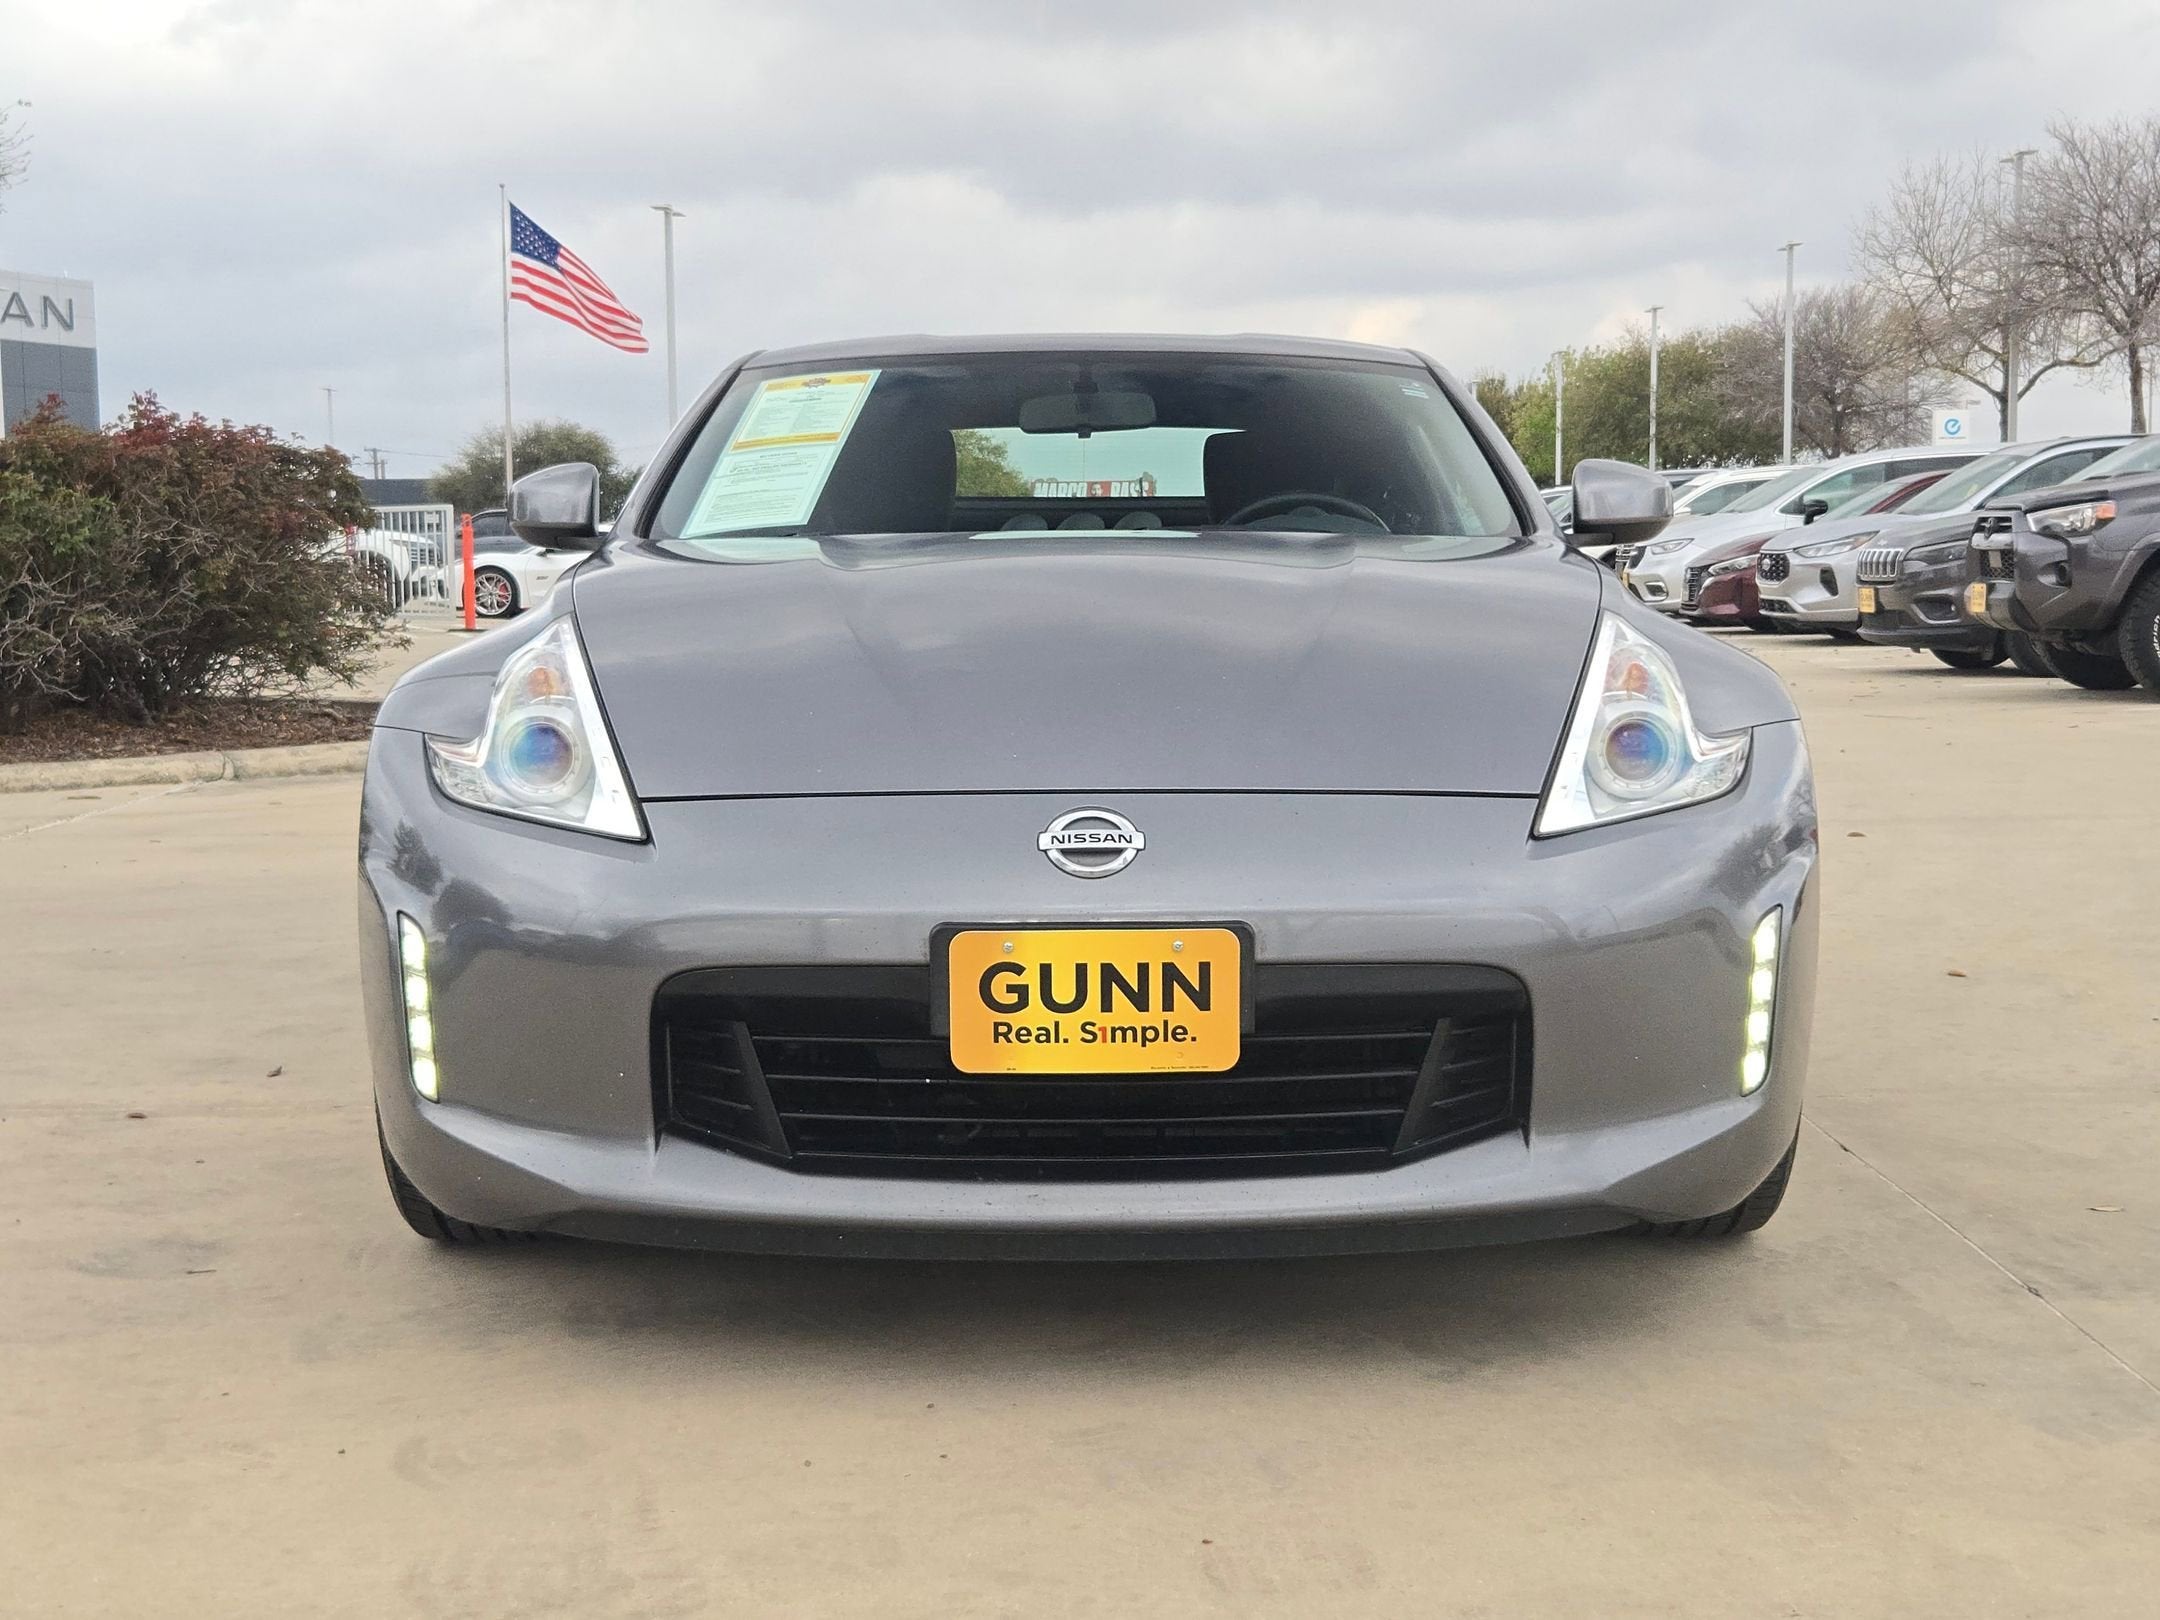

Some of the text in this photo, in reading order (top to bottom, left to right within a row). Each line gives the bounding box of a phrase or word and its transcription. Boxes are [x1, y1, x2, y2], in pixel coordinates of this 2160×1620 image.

[0, 291, 75, 332] AN
[1051, 833, 1133, 845] NISSAN
[978, 961, 1211, 1014] GUNN
[992, 1020, 1070, 1044] Real.
